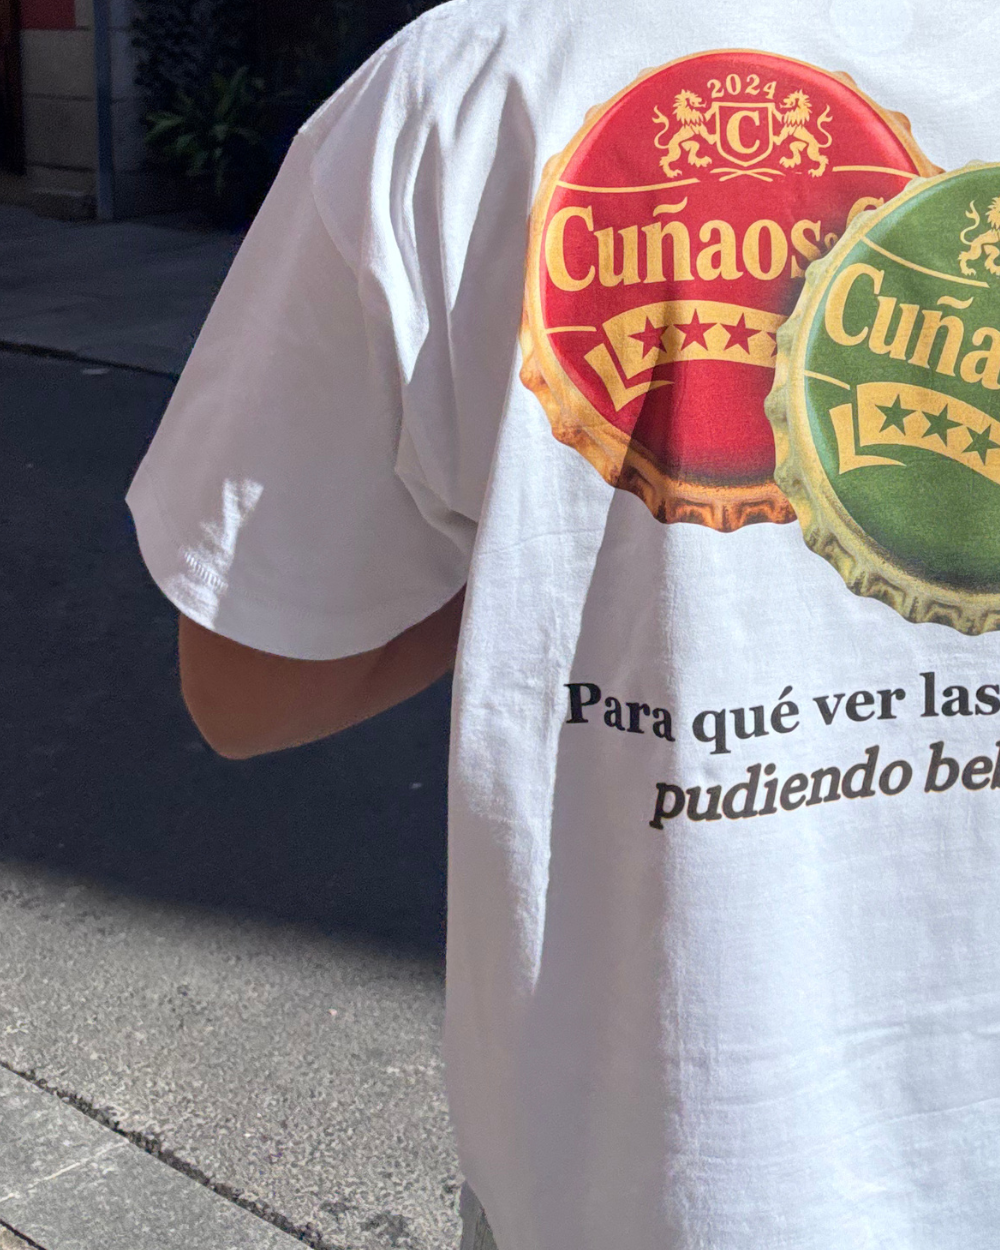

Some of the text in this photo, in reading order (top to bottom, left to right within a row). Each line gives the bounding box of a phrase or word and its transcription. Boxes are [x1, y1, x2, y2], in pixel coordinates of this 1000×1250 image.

[706, 73, 777, 100] 2024
[725, 110, 761, 154] C
[563, 682, 675, 742] Para
[691, 685, 800, 755] qué
[813, 688, 906, 726] ver
[648, 744, 913, 830] pudiendo
